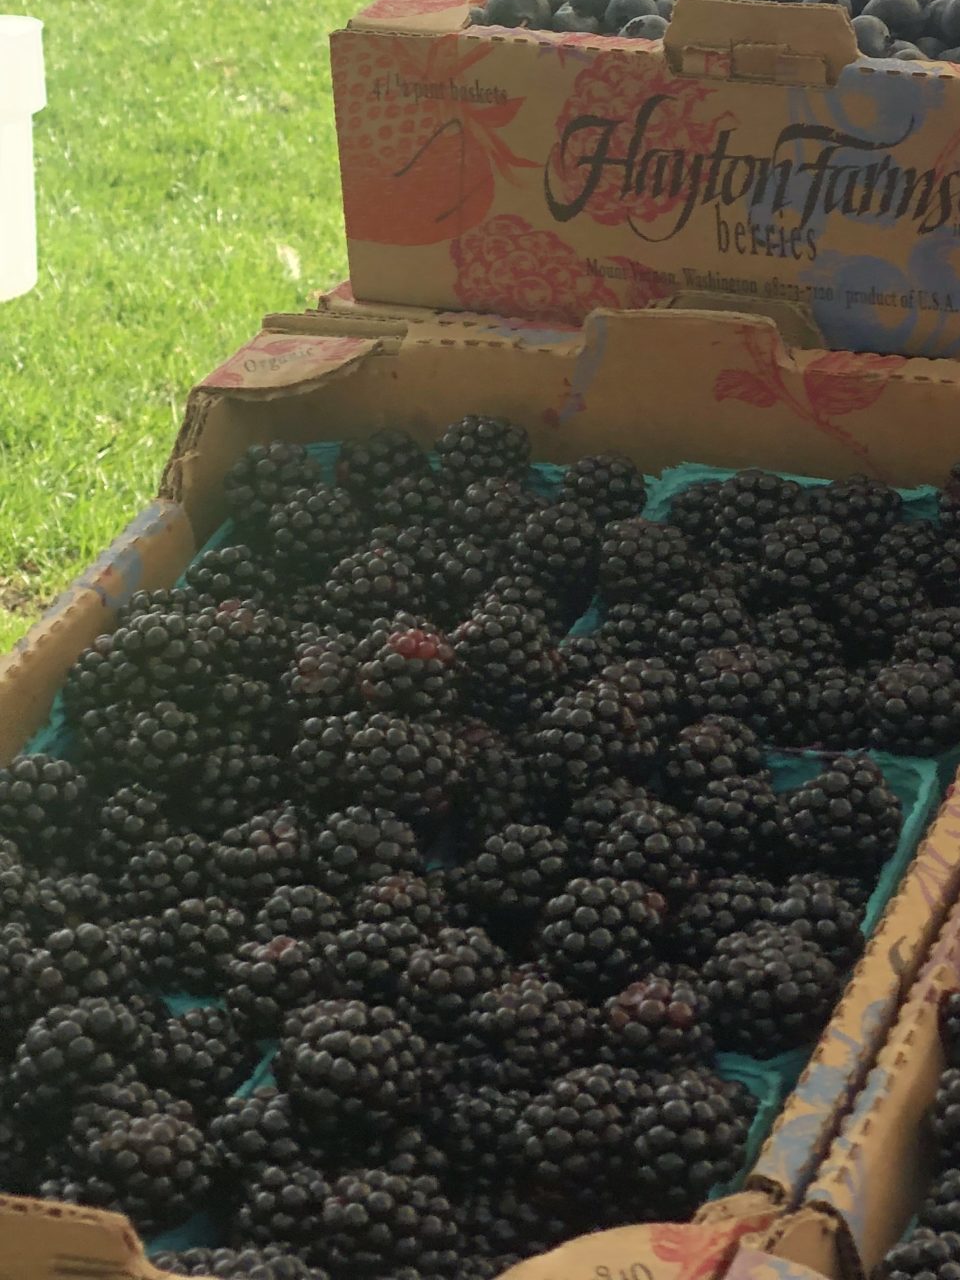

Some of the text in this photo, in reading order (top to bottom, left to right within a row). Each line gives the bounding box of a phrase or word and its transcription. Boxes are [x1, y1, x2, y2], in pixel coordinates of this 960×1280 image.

[448, 77, 508, 105] baskets
[544, 94, 960, 243] Hayton Farms
[716, 203, 818, 262] berries
[586, 257, 627, 279] Mount
[682, 267, 758, 295] Washington
[845, 285, 897, 309] product
[901, 289, 915, 309] of
[244, 346, 314, 373] Organic
